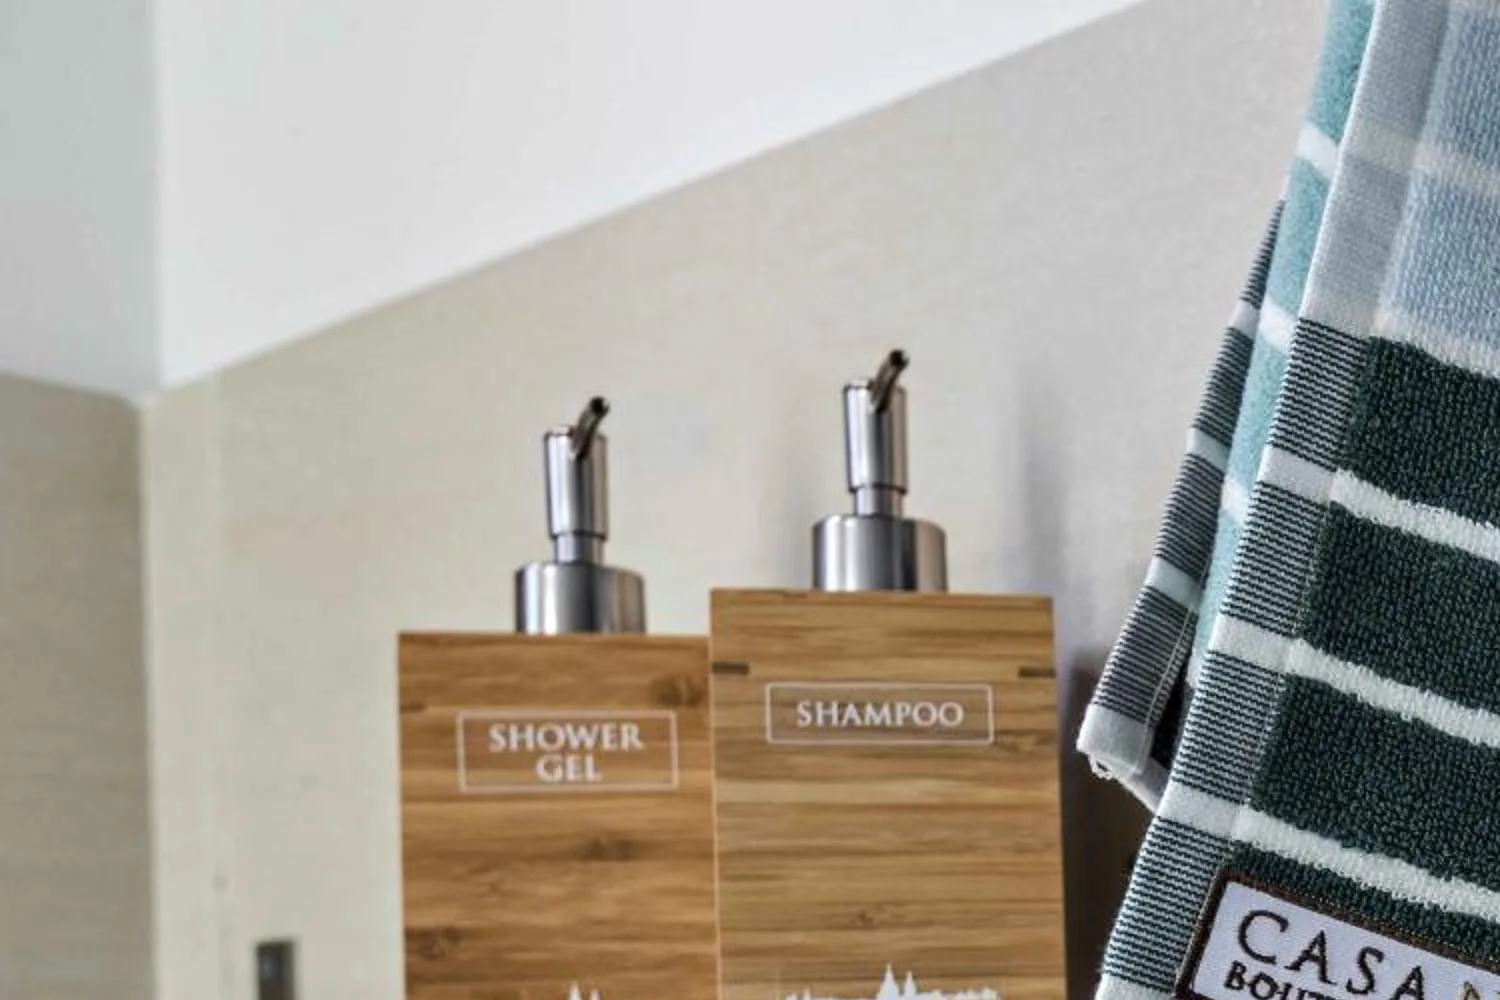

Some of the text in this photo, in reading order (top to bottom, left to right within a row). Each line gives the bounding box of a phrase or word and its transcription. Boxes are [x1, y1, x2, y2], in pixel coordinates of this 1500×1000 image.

[796, 700, 965, 728] SHAMPOO
[489, 723, 645, 751] SHOWER
[535, 753, 603, 783] GEL
